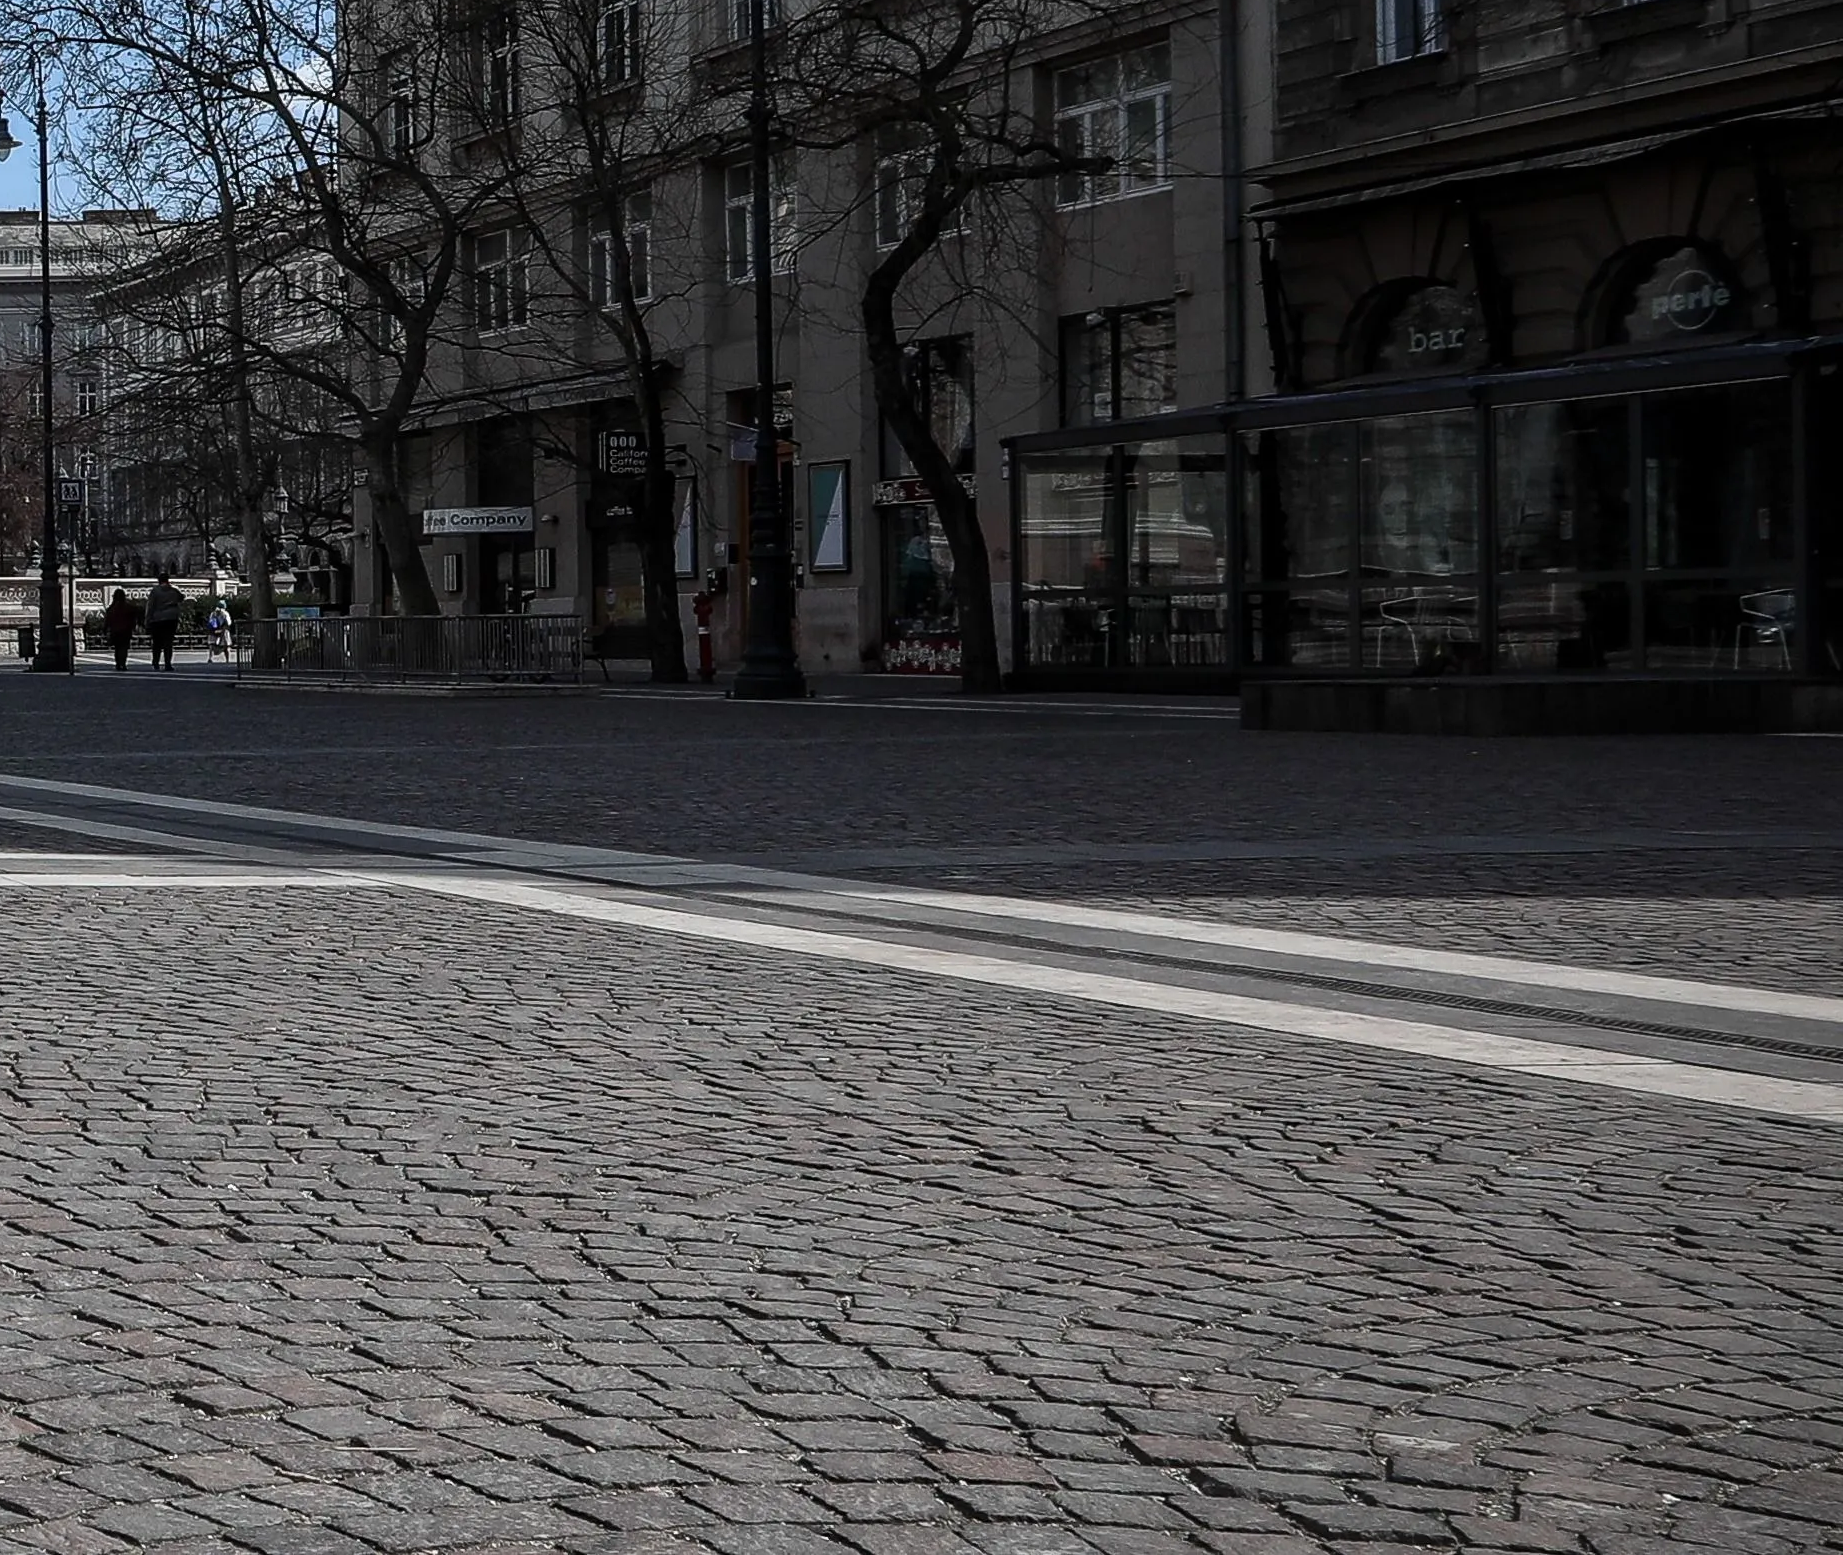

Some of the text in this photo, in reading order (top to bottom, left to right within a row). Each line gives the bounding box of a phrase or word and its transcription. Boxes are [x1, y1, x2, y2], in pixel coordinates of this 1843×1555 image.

[1408, 325, 1465, 353] bar
[609, 457, 646, 466] Coffee
[450, 513, 527, 527] Company
